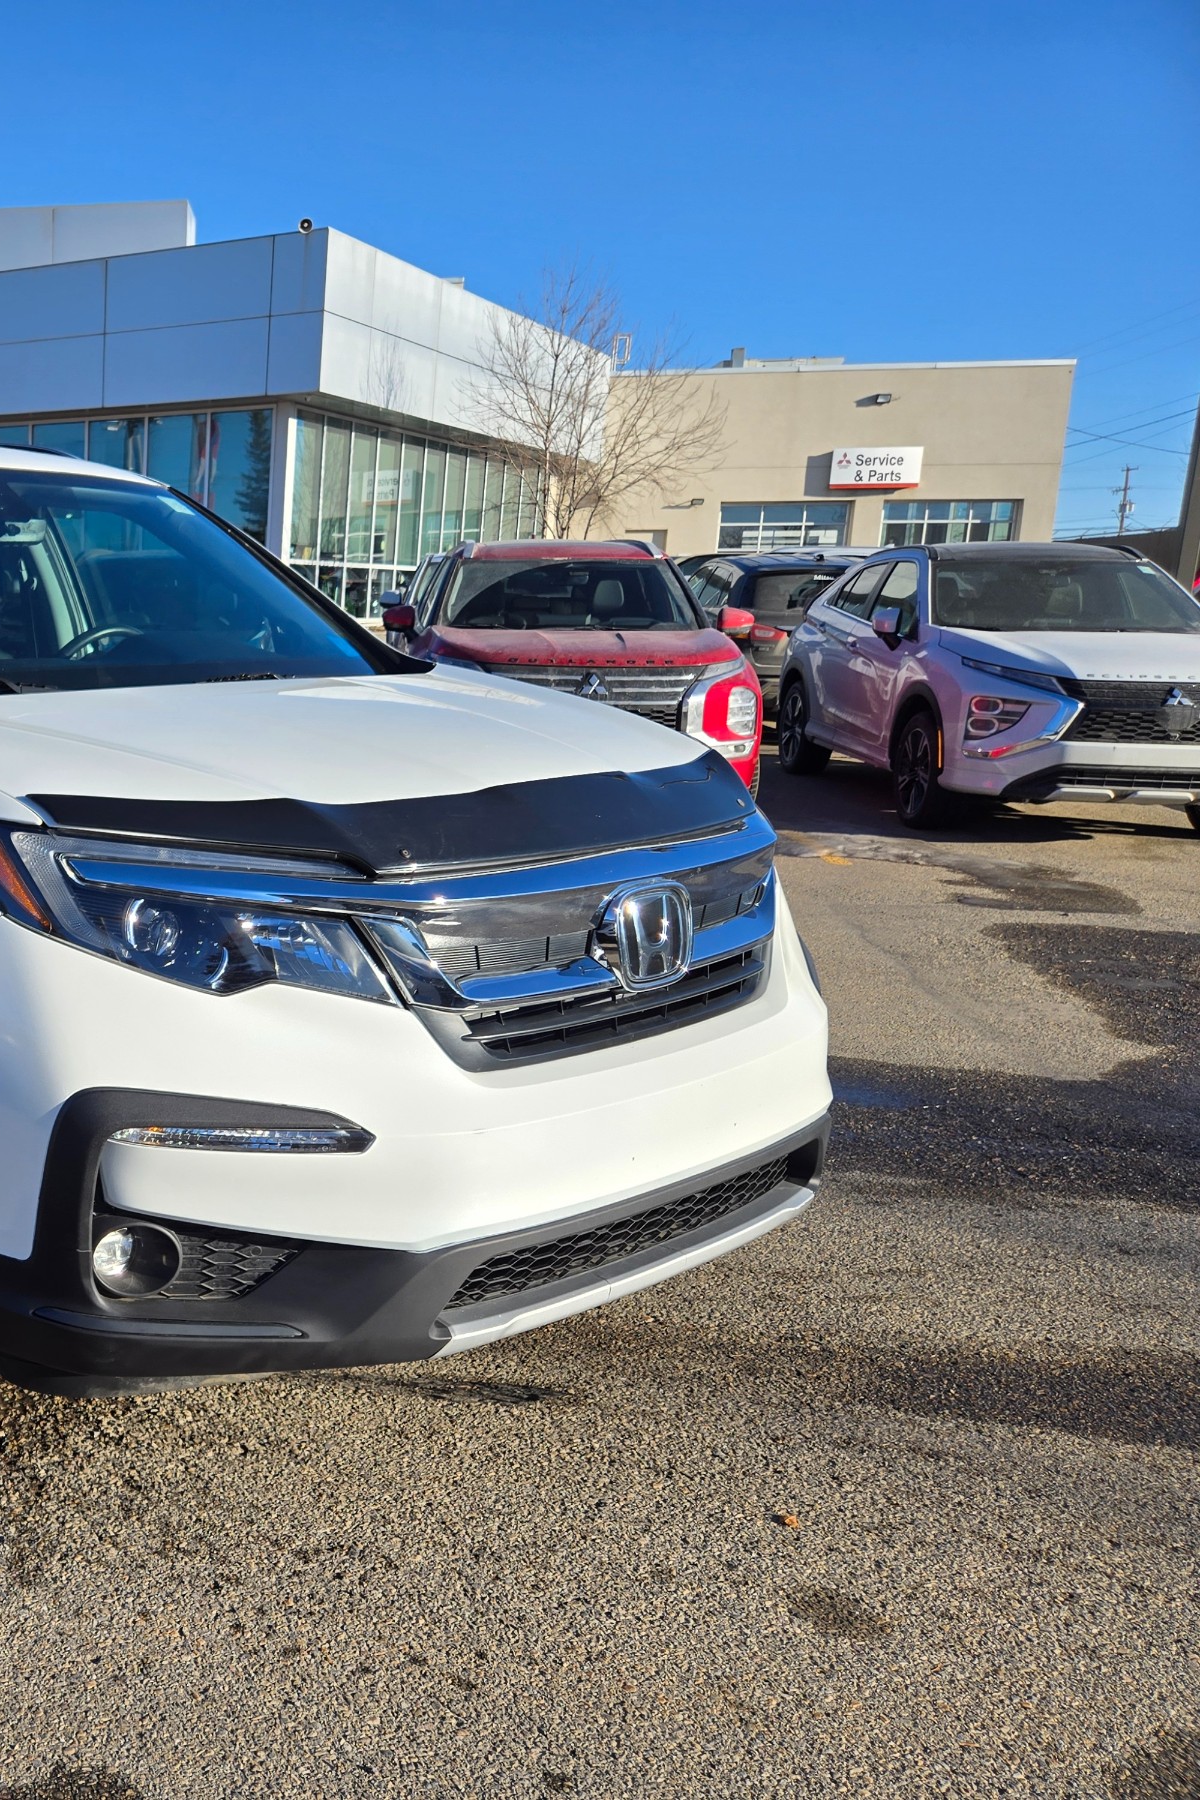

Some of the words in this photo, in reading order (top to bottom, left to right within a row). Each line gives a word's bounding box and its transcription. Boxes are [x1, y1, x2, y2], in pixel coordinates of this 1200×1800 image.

[855, 453, 904, 466] Service
[854, 470, 863, 482] &
[868, 470, 901, 482] Parts
